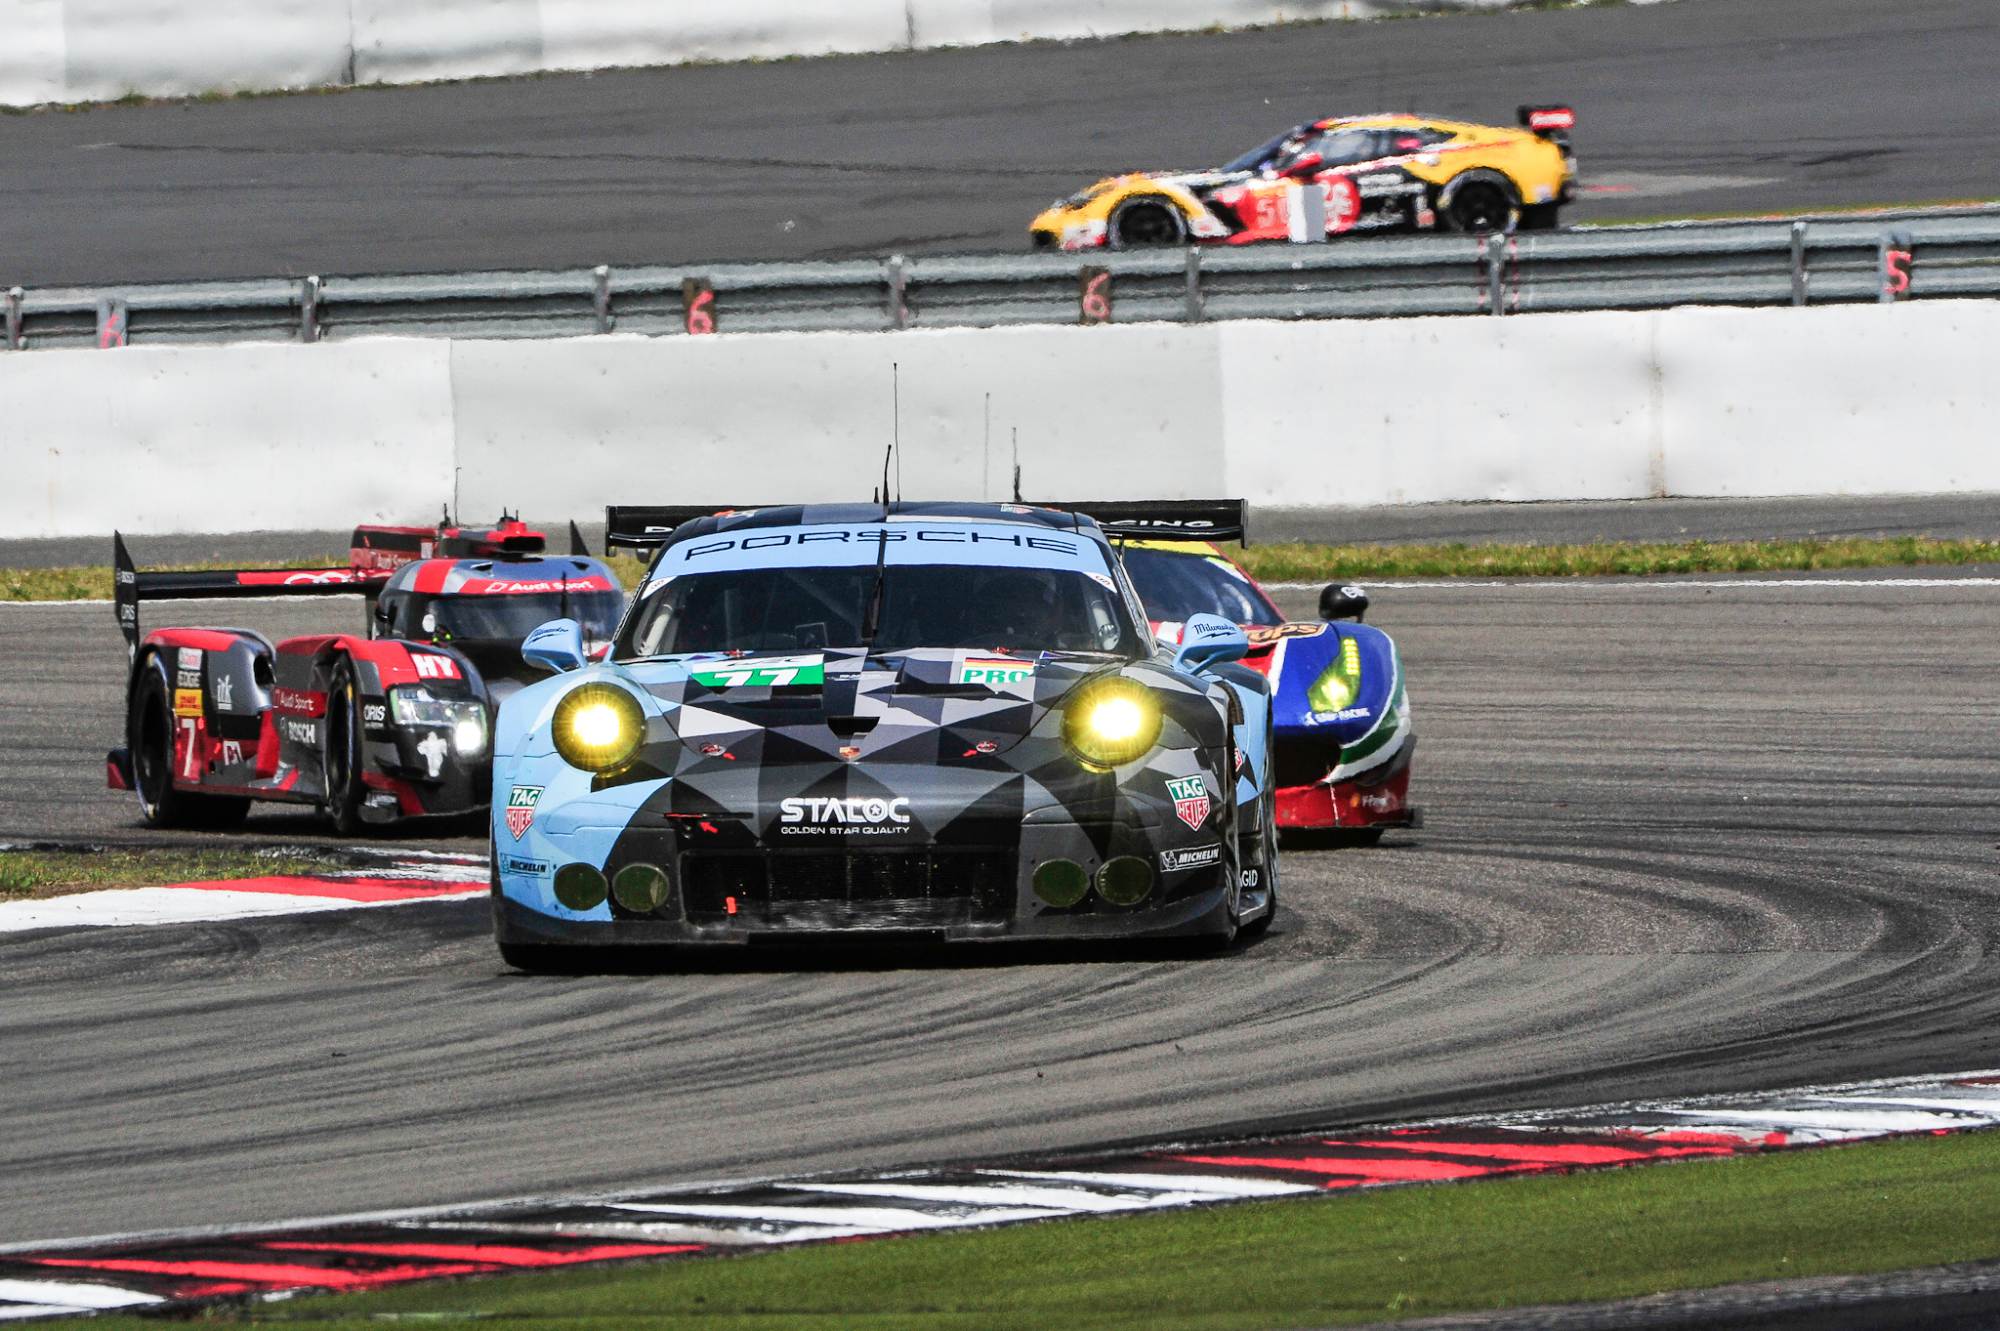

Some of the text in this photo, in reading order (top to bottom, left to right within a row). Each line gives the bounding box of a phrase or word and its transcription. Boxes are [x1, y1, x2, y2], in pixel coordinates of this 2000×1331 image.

[1883, 250, 1912, 295] 5
[1082, 271, 1109, 320] 6
[687, 289, 714, 336] 6
[1097, 519, 1214, 529] CING
[684, 530, 1078, 562] PORSCHE
[508, 581, 551, 592] Audi
[411, 654, 455, 678] HY
[963, 669, 1029, 684] PRO
[714, 668, 799, 687] 77
[364, 705, 386, 722] ORIS
[288, 721, 316, 744] BOSCH
[181, 718, 196, 777] 7
[511, 788, 540, 806] TAG
[1169, 779, 1204, 799] TAG
[780, 797, 910, 823] STALOC
[1177, 799, 1209, 826] HEUER
[507, 809, 533, 836] HEUER
[780, 826, 910, 835] GOLDEN STAR QUALITY
[510, 859, 547, 873] MICHELIN
[1178, 848, 1219, 864] MICHELIN
